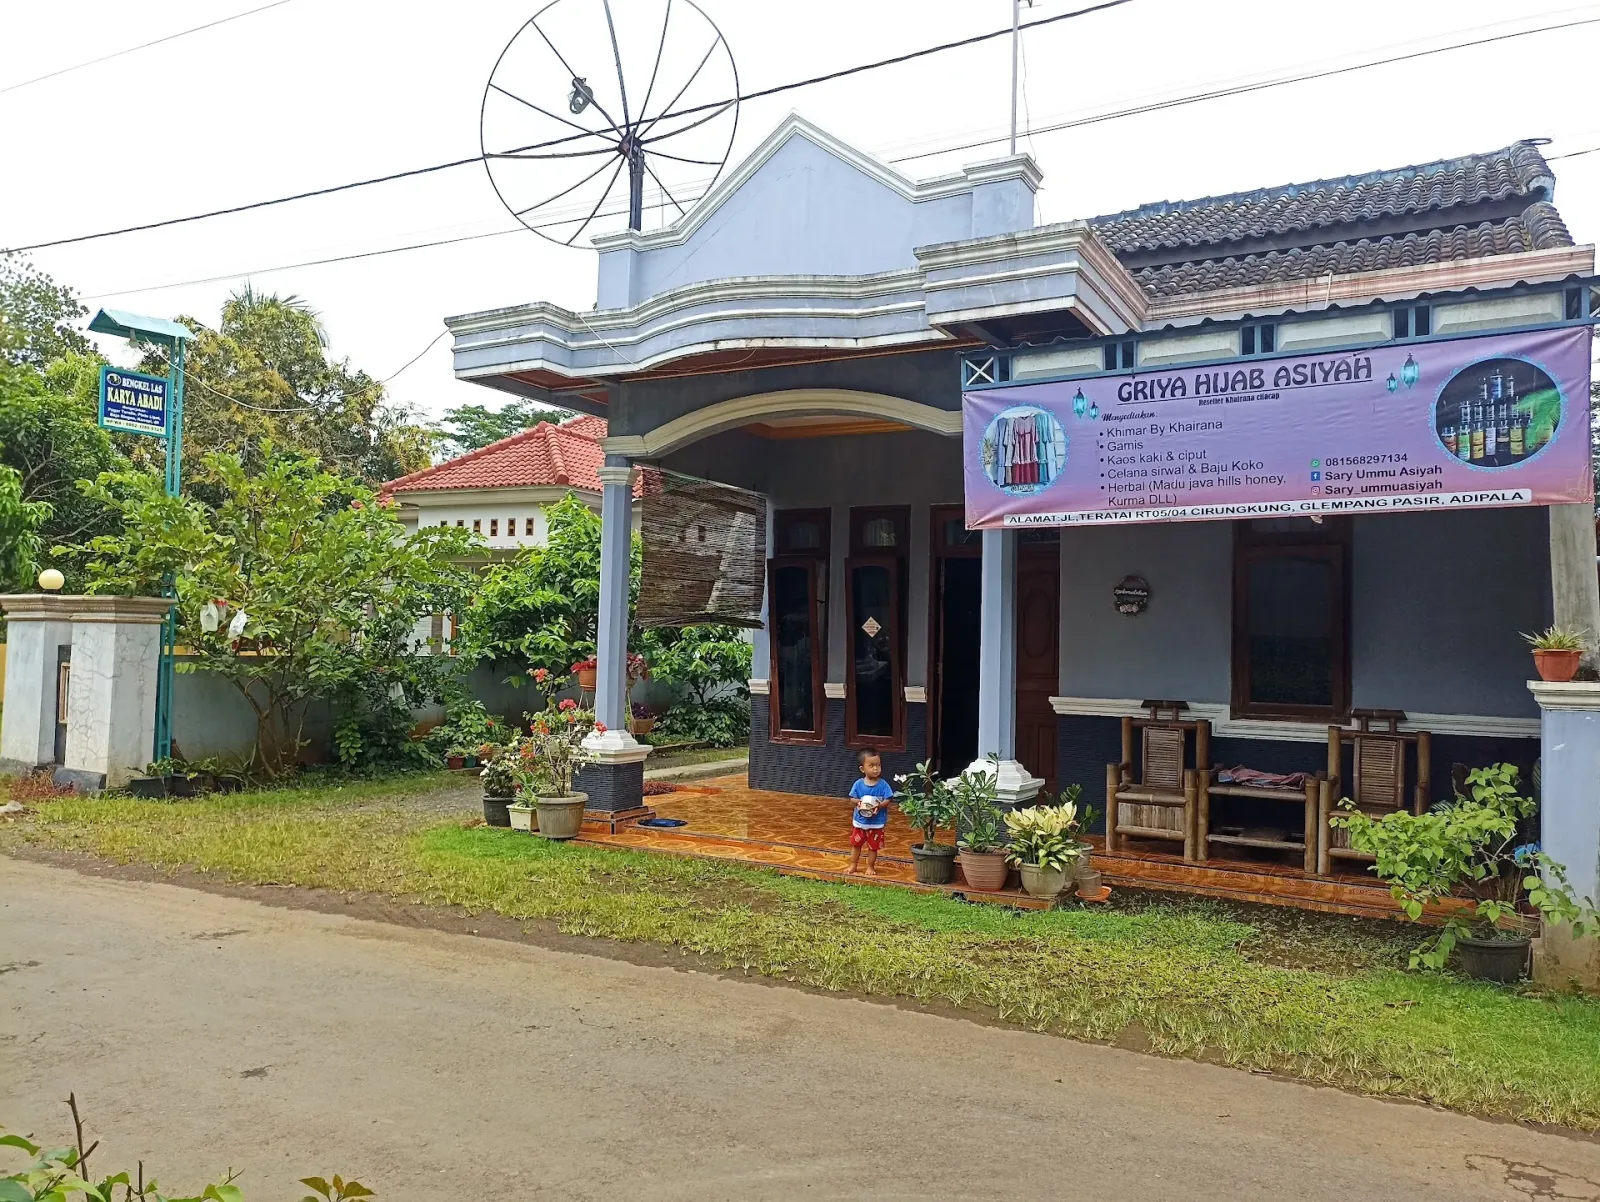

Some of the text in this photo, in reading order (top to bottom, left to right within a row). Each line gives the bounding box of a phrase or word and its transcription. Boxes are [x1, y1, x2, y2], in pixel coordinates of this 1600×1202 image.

[122, 378, 163, 394] BENGKEL LAS
[1117, 357, 1372, 402] GRIYA HIJAB ASIYAH
[107, 387, 163, 411] KARYA ABADI
[1198, 397, 1223, 406] Reseller
[1225, 394, 1255, 404] Khairana
[1101, 410, 1158, 422] Menyediakan:
[1106, 420, 1223, 438] Khimar By Khairana
[1107, 440, 1144, 452] Gamis
[1107, 449, 1207, 465] Kaos kaki & ciput
[1325, 453, 1408, 467] 081568297134
[1107, 460, 1264, 479] Celana sirwal & Baju Koko
[1324, 465, 1443, 482] Sary Ummu Asiyah
[1108, 481, 1145, 493] Herbal
[1148, 479, 1185, 492] (Madu
[1188, 477, 1214, 490] java
[1217, 475, 1242, 487] hills
[1324, 479, 1443, 496] Sary_ummuasiyah
[1108, 494, 1177, 507] Kurma DLL)
[1135, 508, 1187, 518] RT05/04
[1190, 503, 1296, 517] CIRUNGKUNG,
[1299, 498, 1388, 511] GLEMPANG
[1449, 492, 1524, 503] ADIPALA
